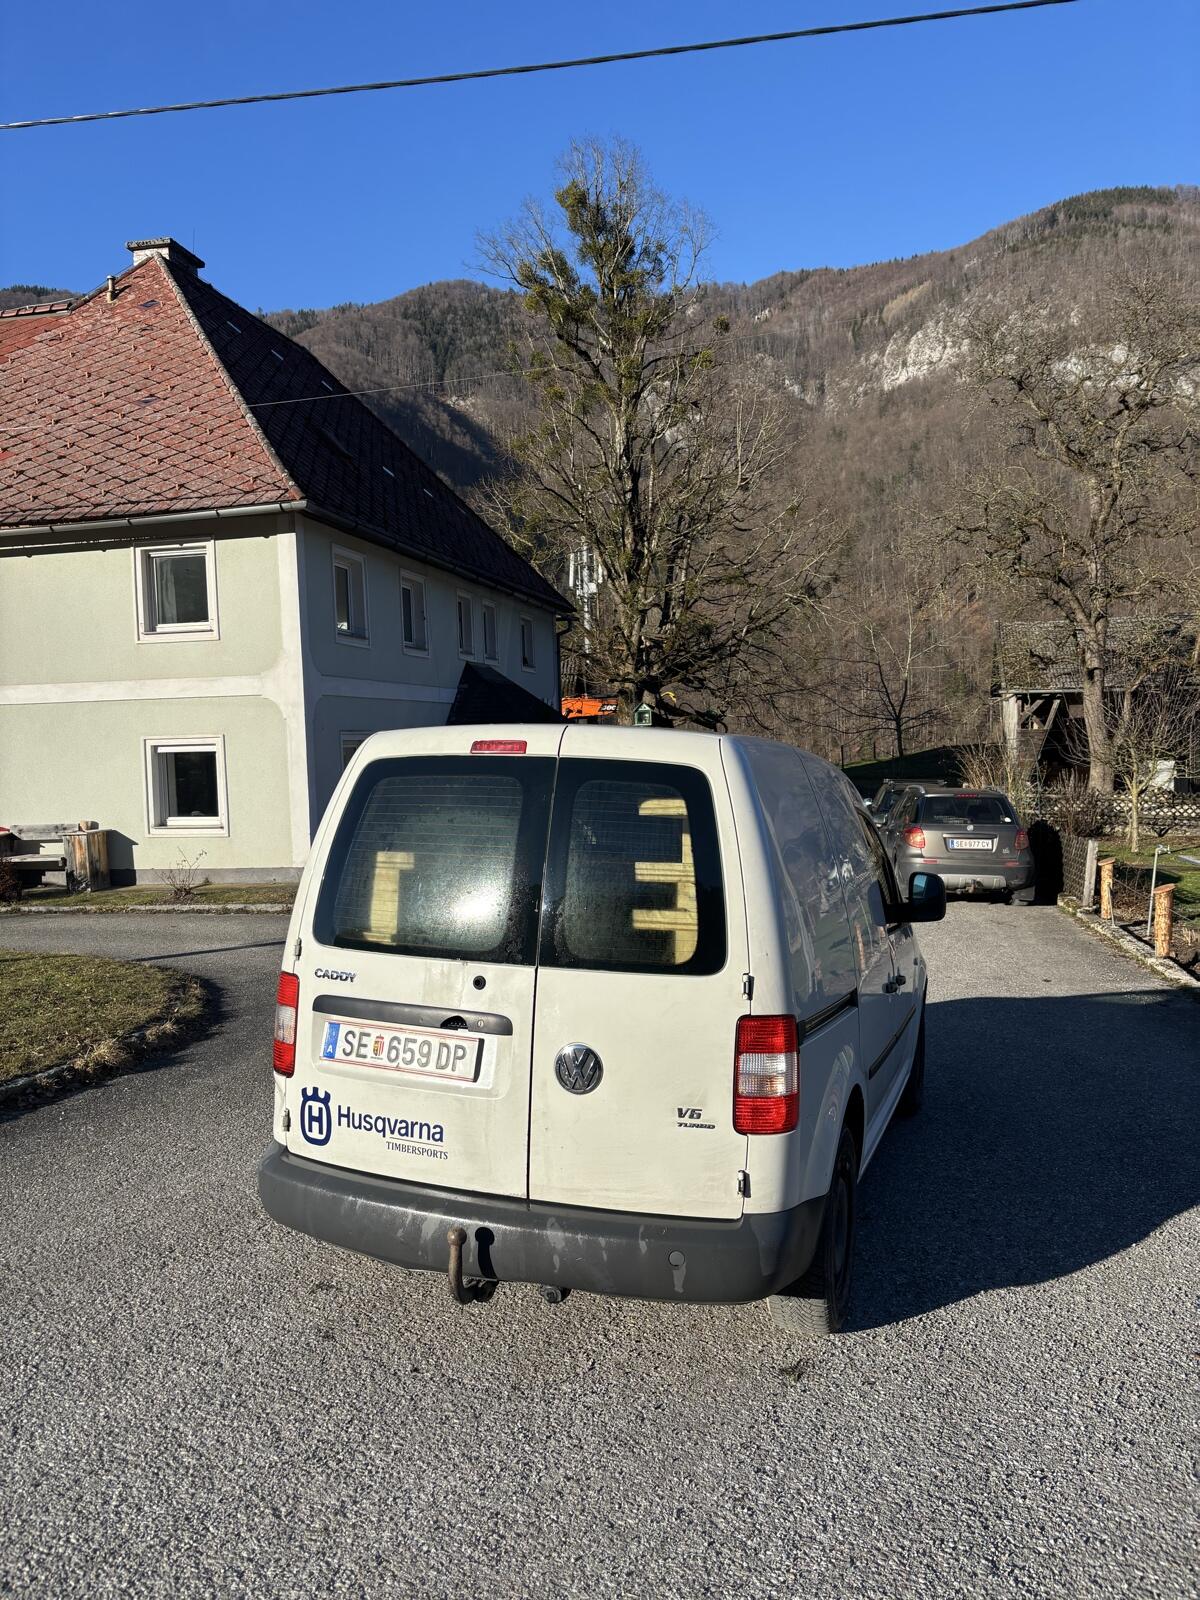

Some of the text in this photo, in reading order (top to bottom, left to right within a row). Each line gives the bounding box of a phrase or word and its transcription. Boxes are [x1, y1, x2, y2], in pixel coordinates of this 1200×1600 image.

[955, 840, 990, 848] SE 977 CV
[314, 968, 357, 983] CADDY
[342, 1030, 468, 1072] SE 659 DP
[677, 1107, 703, 1120] V6
[337, 1105, 444, 1143] Husqvarna
[677, 1121, 716, 1130] TURBO
[386, 1141, 449, 1160] TIMBERSPORTS
